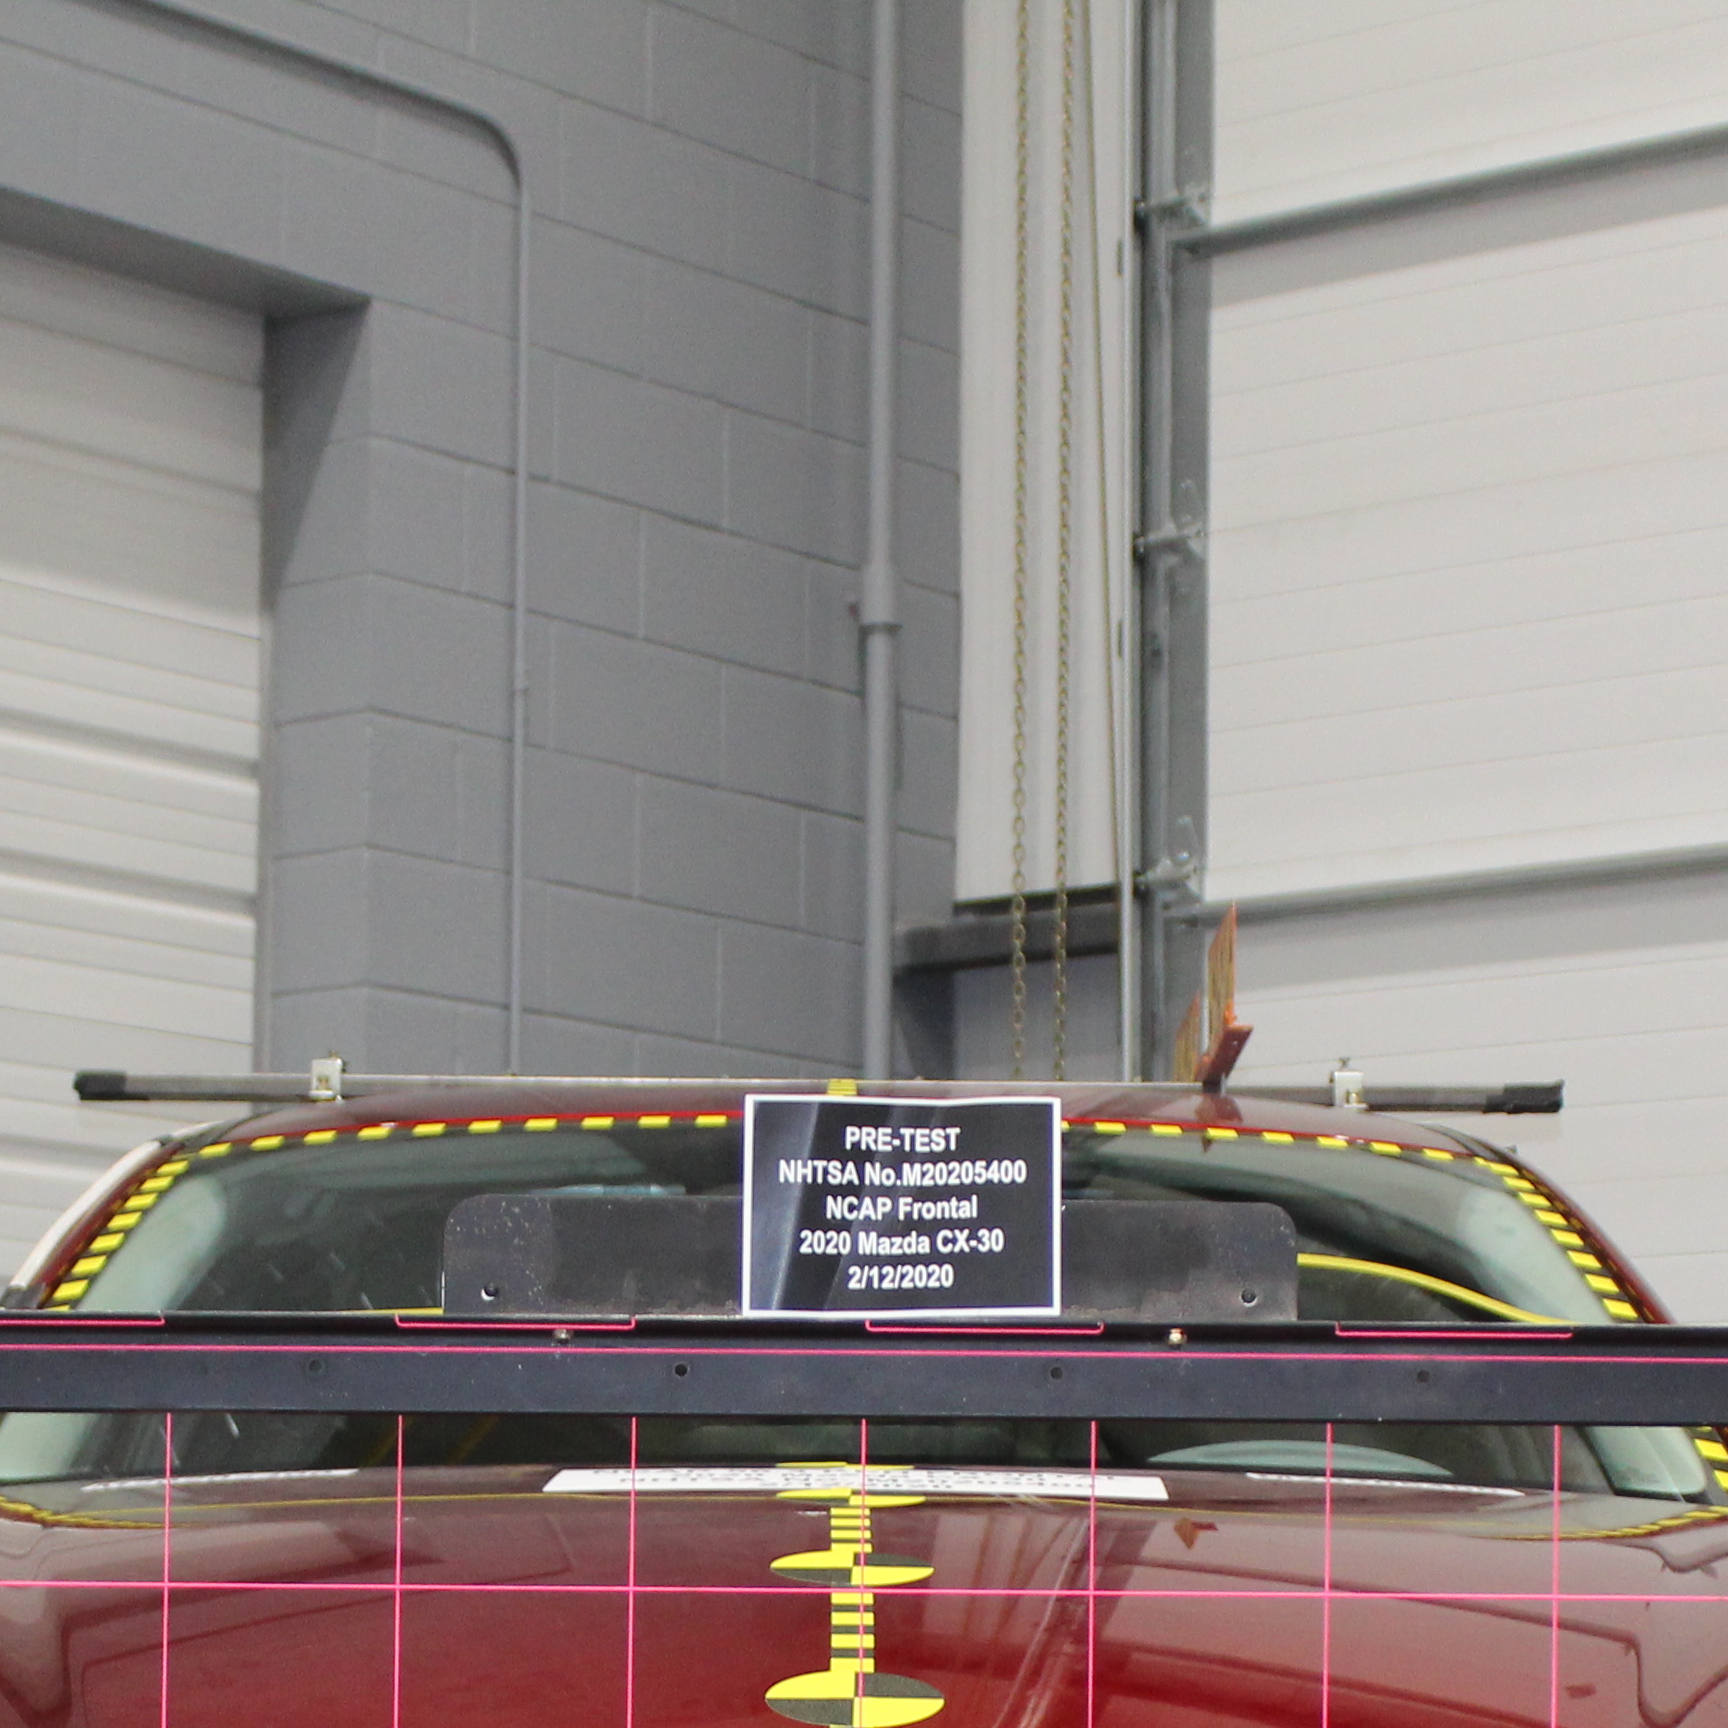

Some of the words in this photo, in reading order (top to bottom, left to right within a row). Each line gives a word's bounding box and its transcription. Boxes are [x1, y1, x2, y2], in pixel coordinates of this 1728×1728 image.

[845, 1126, 960, 1152] PRE-TEST
[779, 1160, 859, 1186] NHTSA
[864, 1160, 1027, 1187] No.M20205400
[826, 1196, 893, 1220] NCAP
[898, 1194, 978, 1219] Frontal
[800, 1230, 851, 1255] 2020
[858, 1231, 930, 1255] Mazda
[937, 1228, 1005, 1253] CX-30
[848, 1264, 954, 1290] 2/12/2020
